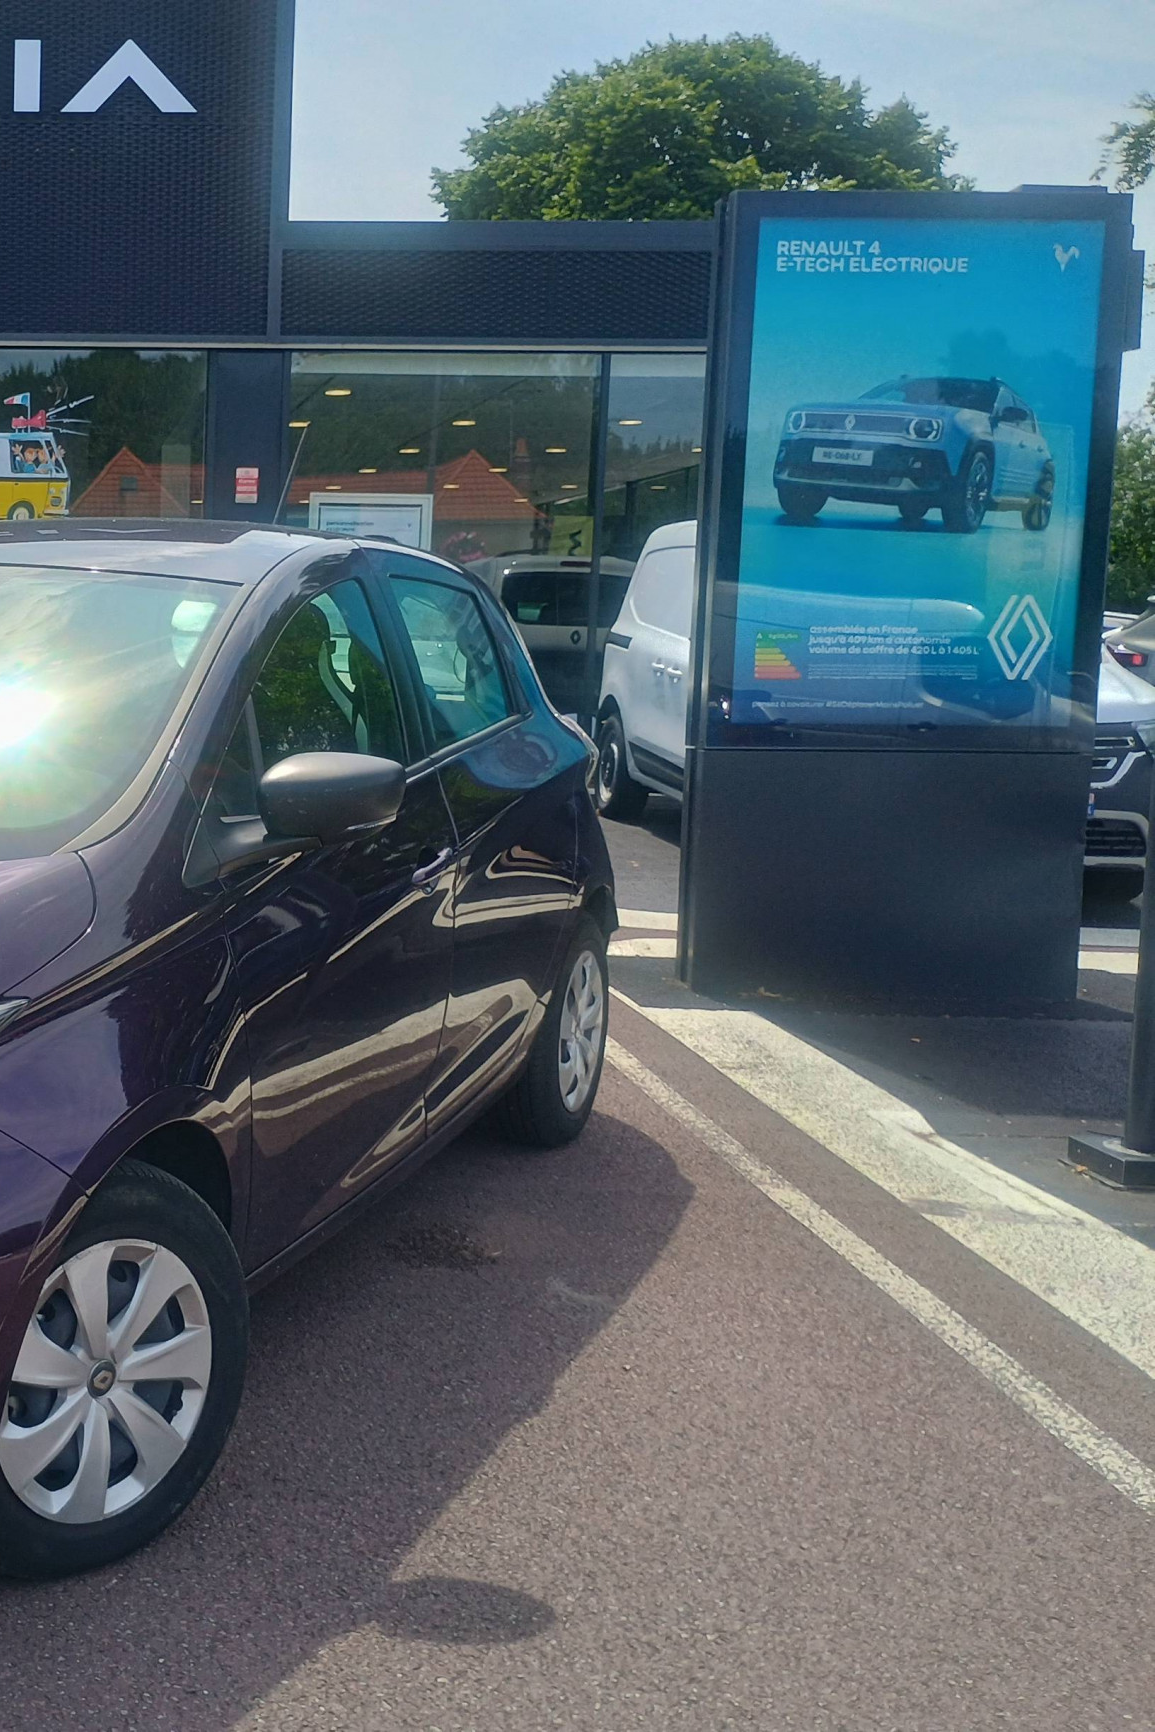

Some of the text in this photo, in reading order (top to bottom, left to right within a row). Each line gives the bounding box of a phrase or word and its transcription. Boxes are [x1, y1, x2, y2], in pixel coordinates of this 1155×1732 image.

[777, 240, 881, 256] RENAULT 4
[776, 256, 968, 273] E-TECH ELECTRIQUE
[867, 626, 880, 634] en
[882, 625, 918, 634] France
[868, 635, 884, 644] km
[809, 645, 846, 654] volume
[848, 645, 861, 654] de
[862, 645, 895, 654] coffre
[895, 645, 910, 655] de
[910, 646, 930, 655] 420
